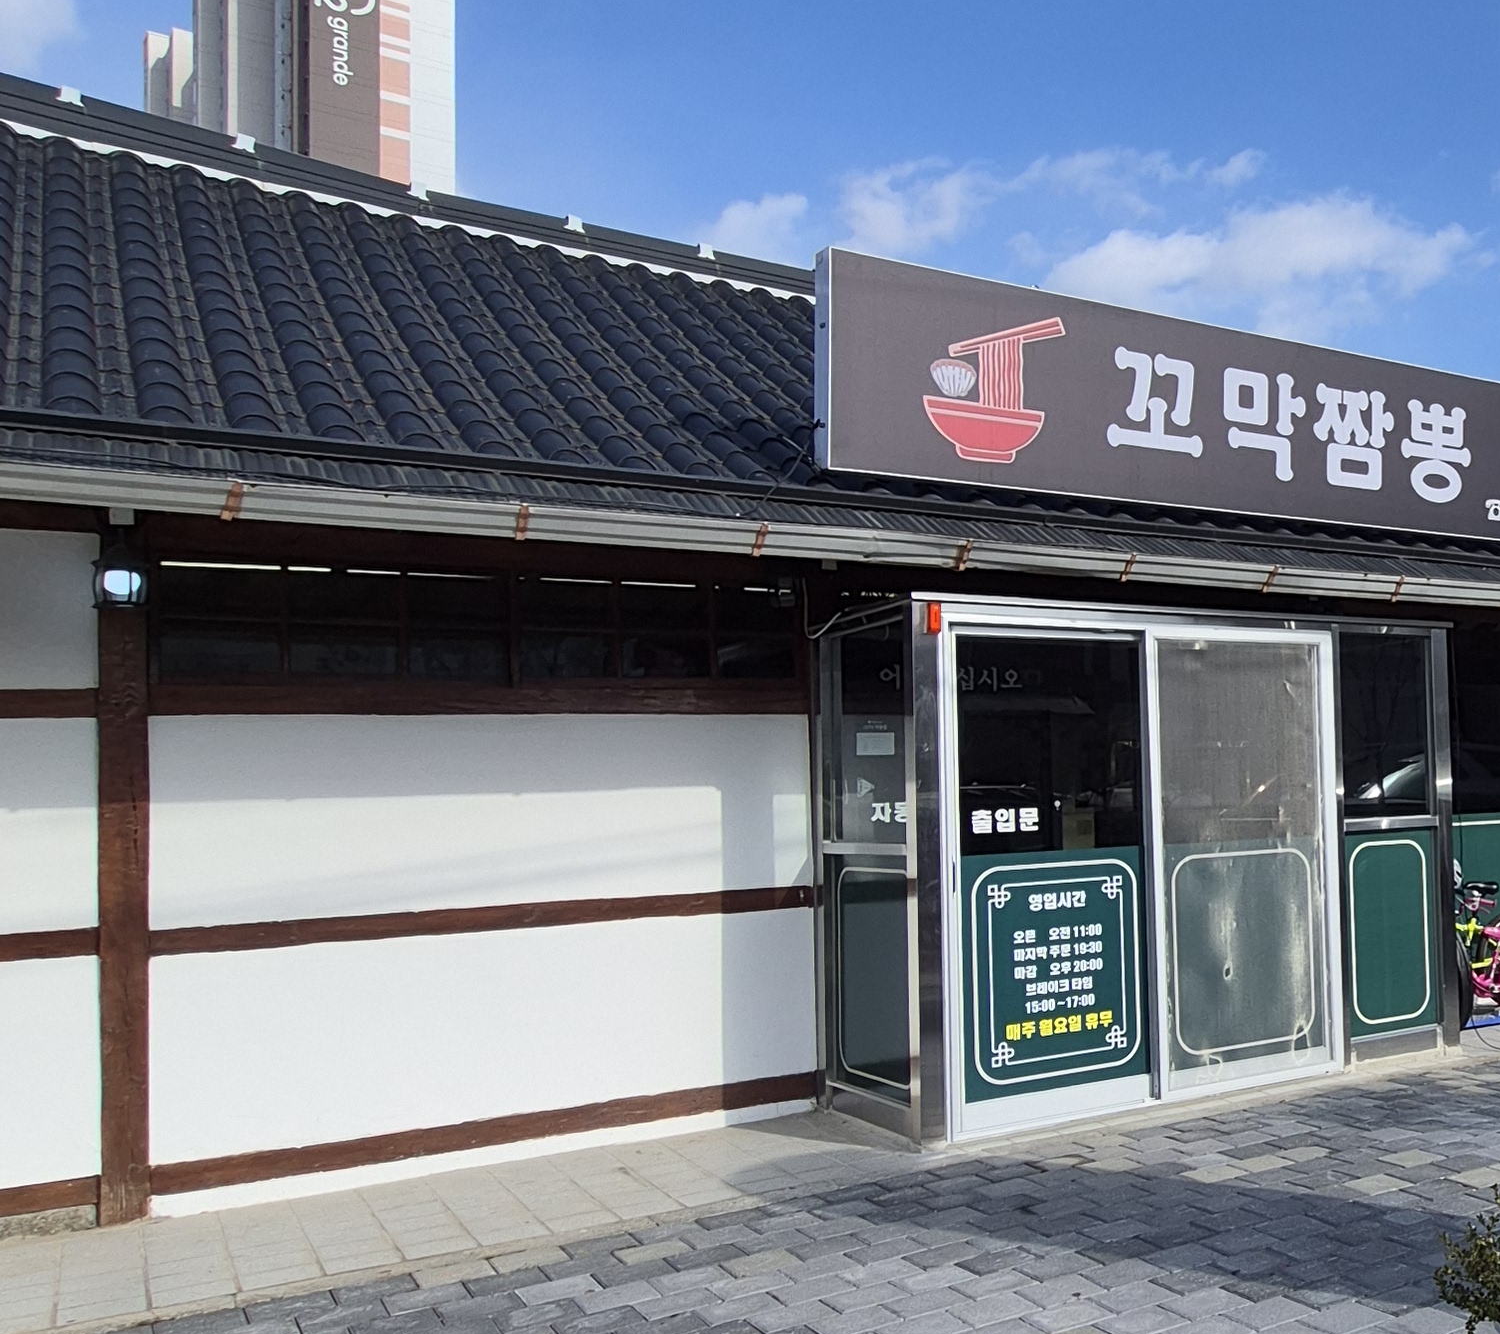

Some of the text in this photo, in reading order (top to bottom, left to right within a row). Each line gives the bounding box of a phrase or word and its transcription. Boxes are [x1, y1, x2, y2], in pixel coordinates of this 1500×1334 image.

[327, 15, 354, 86] grande
[1107, 346, 1472, 504] 꼬막짬뽕
[971, 807, 1039, 834] 출입문
[1028, 890, 1086, 911] 영업시간
[1013, 923, 1102, 943] 오픈 오전 11:00
[1013, 940, 1102, 961] 마지막 주문 19:30
[1014, 958, 1103, 979] 마감 오후 20:00
[1025, 976, 1093, 995] 브레이크 타임
[1005, 1010, 1113, 1040] 매주 월요일 휴무
